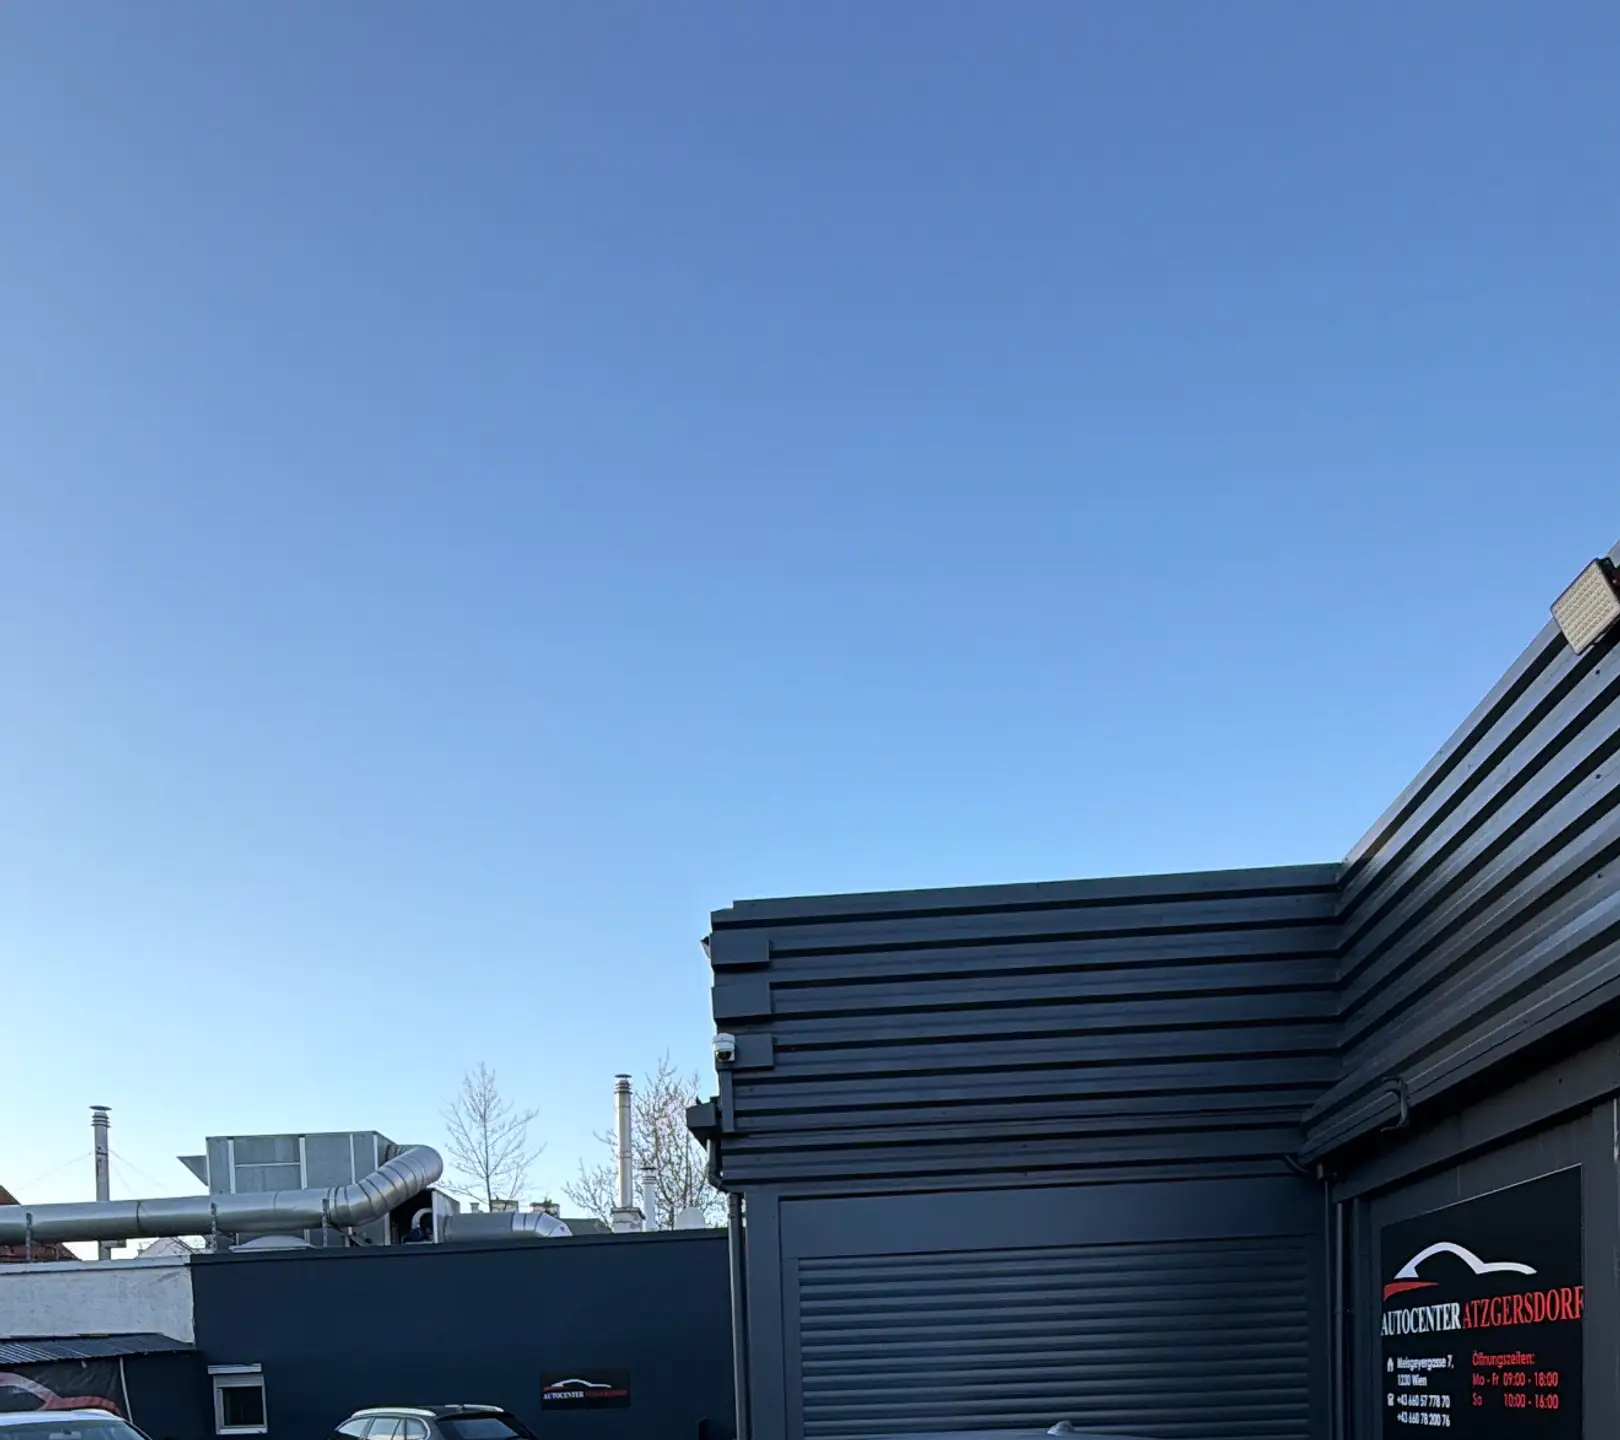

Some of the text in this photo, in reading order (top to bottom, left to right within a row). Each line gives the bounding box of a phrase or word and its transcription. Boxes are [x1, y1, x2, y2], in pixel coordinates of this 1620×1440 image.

[1380, 1286, 1584, 1336] AUTOCENTER ATZGERSDORF
[1412, 1374, 1428, 1386] Wien
[1472, 1372, 1484, 1386] Mo
[1492, 1372, 1498, 1386] Fr
[1503, 1372, 1526, 1386] 09:00
[1534, 1372, 1558, 1387] 18:00
[1441, 1394, 1450, 1408] 70
[1504, 1393, 1526, 1408] 10:00
[1534, 1394, 1558, 1409] 16:00
